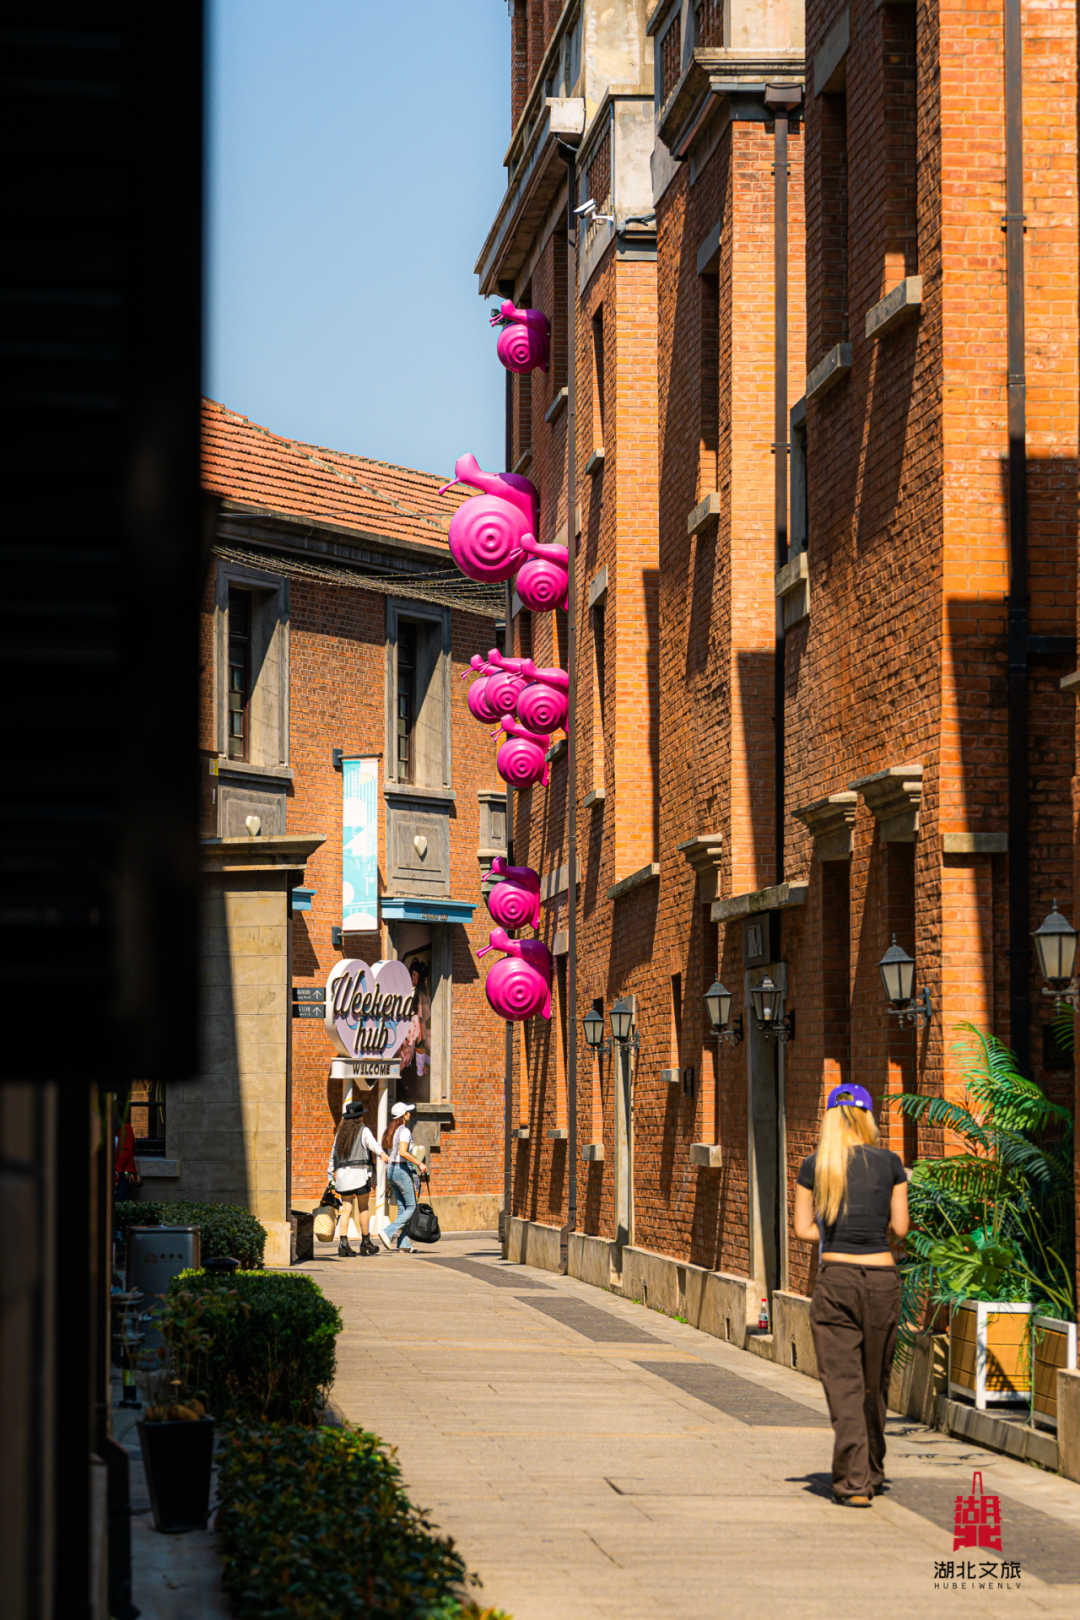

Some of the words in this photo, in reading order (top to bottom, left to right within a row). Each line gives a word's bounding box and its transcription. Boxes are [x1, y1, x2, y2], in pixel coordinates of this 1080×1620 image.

[331, 969, 416, 1019] Weekend
[353, 1018, 389, 1053] hub
[352, 1063, 391, 1076] WELCOME
